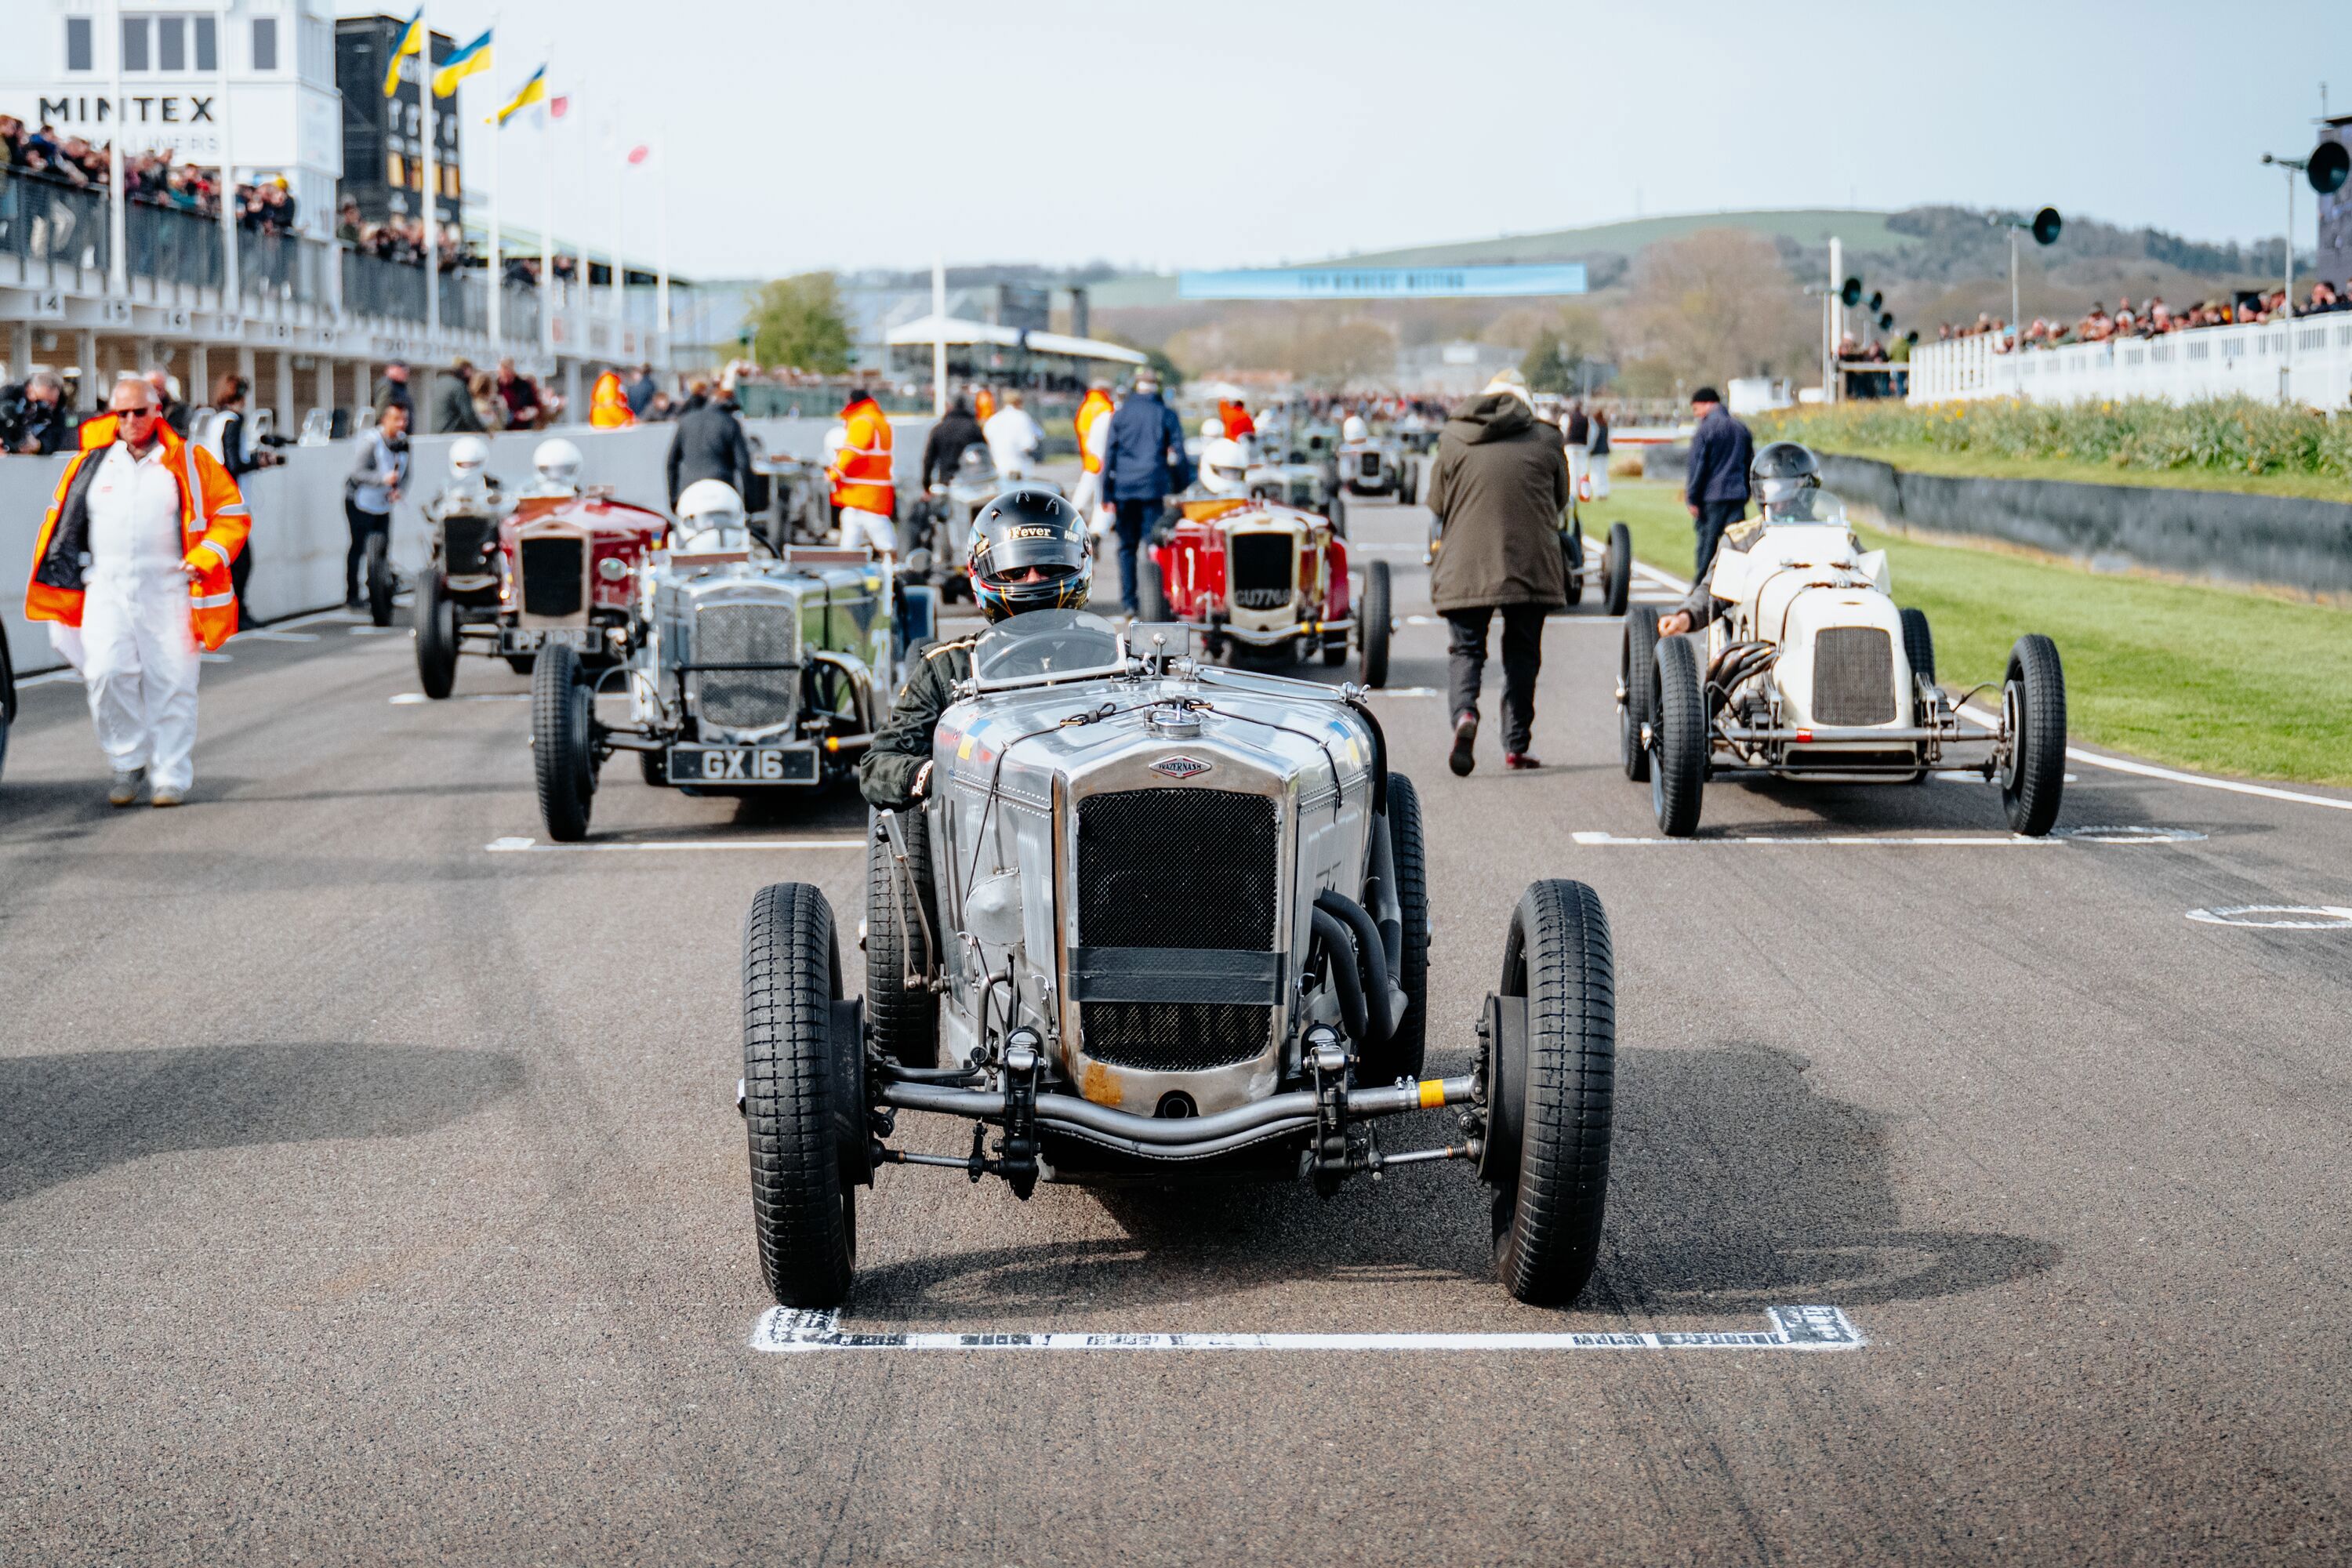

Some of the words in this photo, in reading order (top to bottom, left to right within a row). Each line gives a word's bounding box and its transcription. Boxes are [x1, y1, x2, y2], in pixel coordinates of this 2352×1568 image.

[39, 96, 213, 122] MINTEX
[702, 750, 745, 779] GX
[751, 750, 783, 779] 16
